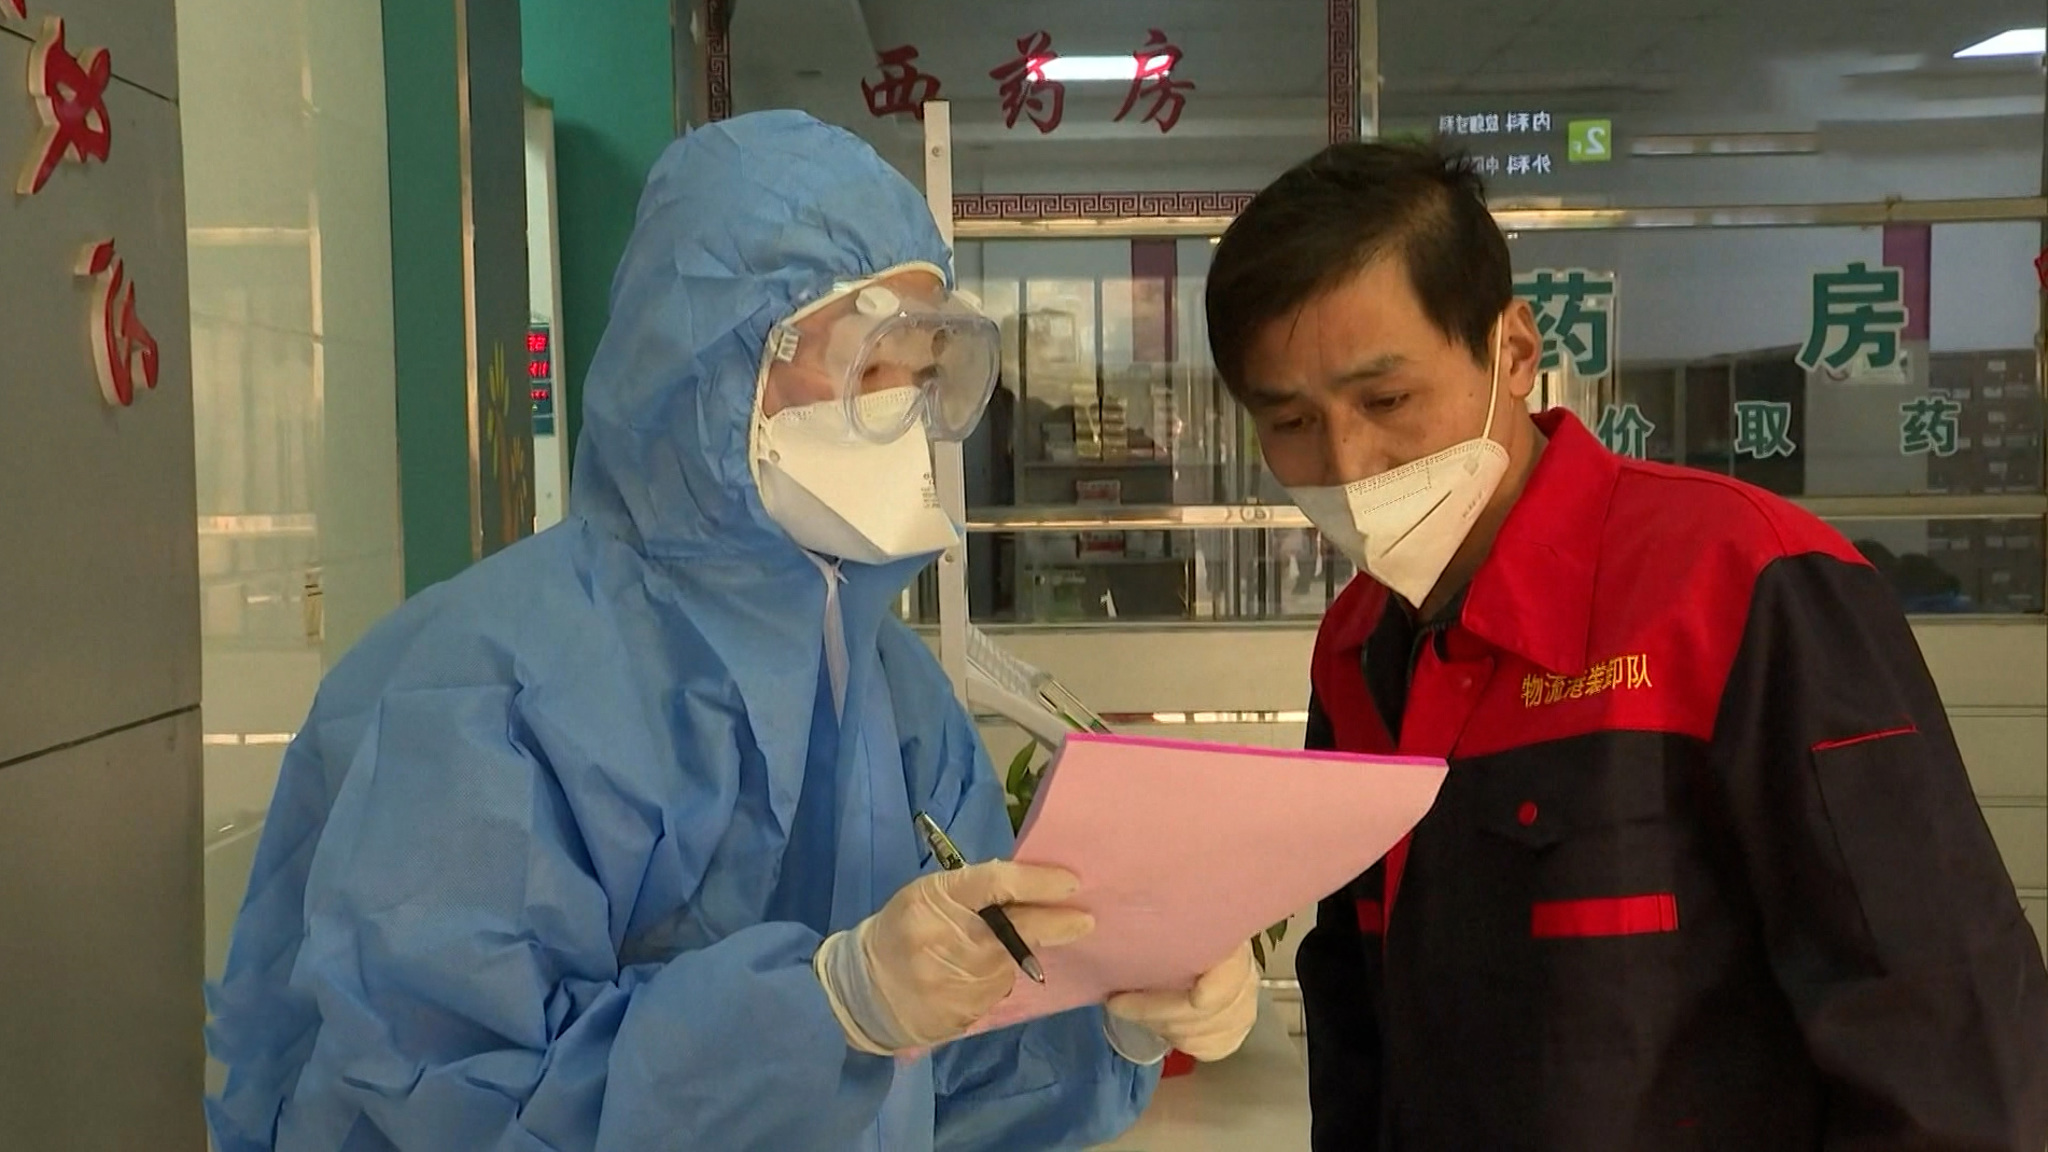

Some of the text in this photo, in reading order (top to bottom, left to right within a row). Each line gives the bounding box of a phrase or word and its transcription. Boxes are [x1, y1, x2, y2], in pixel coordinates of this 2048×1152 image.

[861, 28, 1196, 134] 西药房
[1510, 262, 1905, 377] 药房
